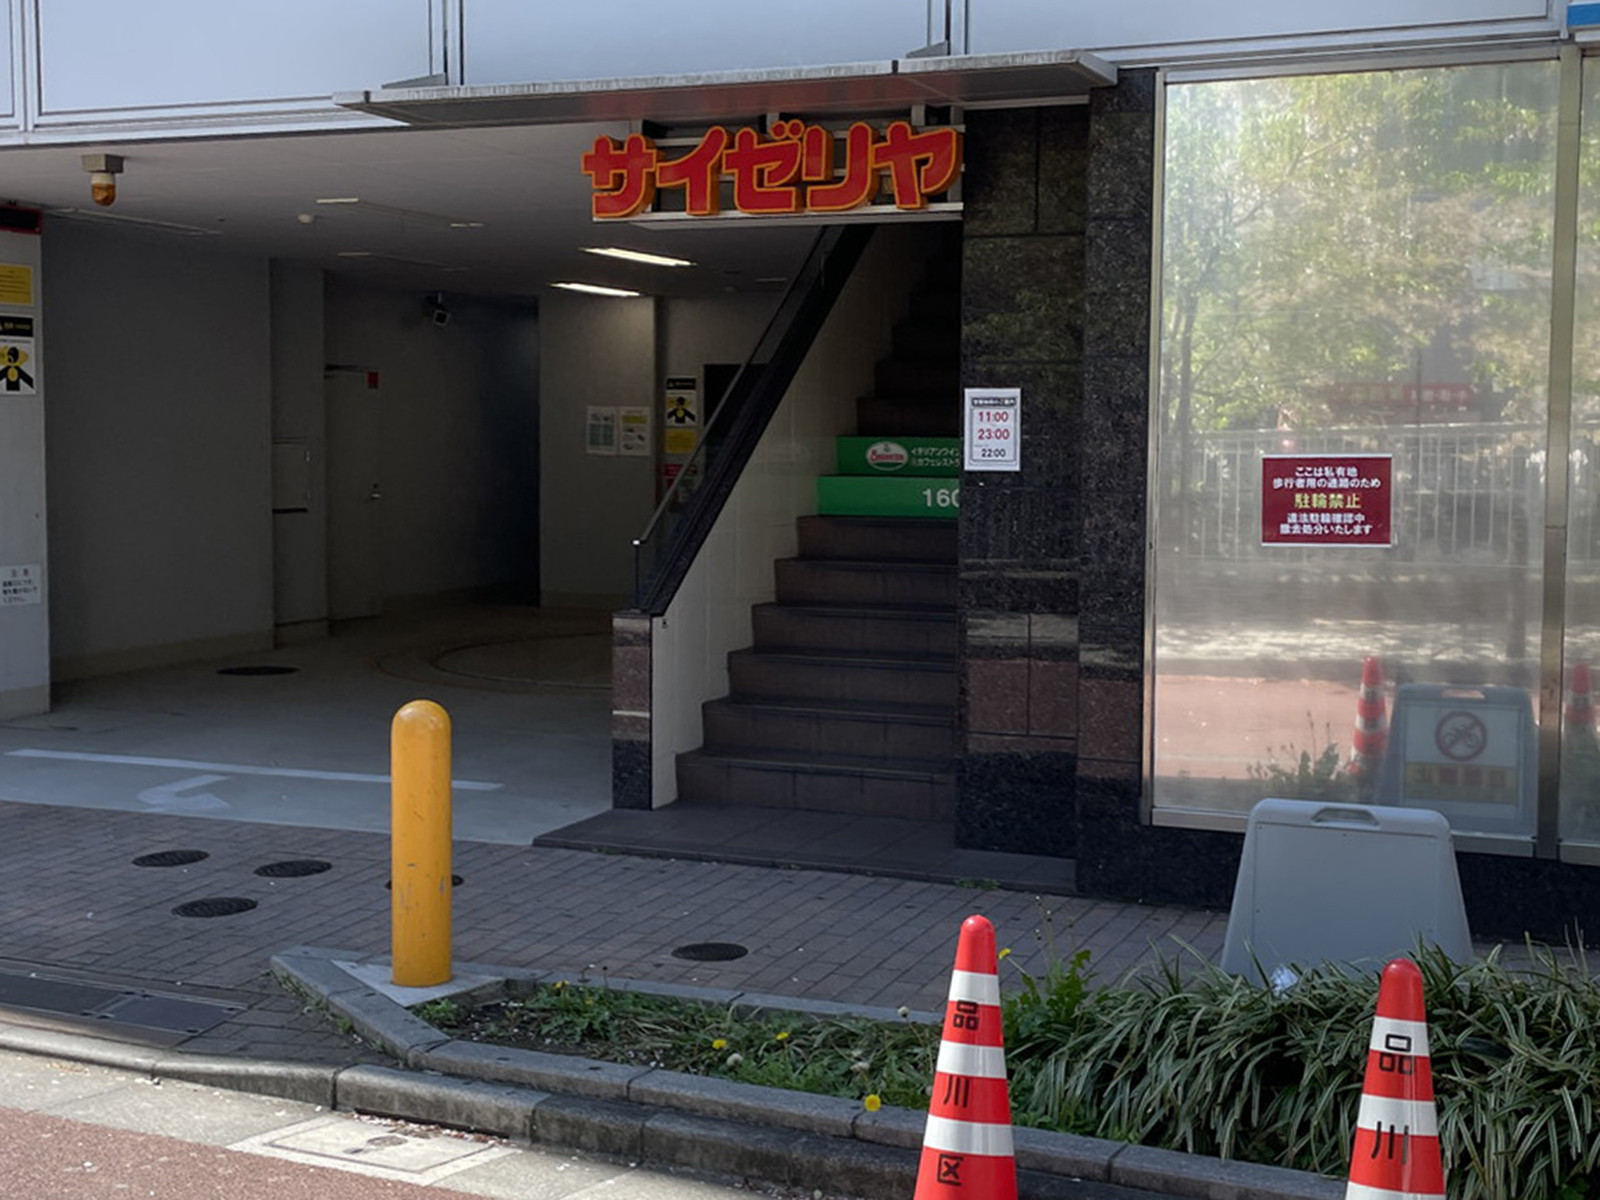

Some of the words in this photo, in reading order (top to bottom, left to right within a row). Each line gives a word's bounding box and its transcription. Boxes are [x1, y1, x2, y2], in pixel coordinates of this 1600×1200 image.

[581, 119, 963, 218] サイゼリヤ
[978, 411, 1009, 422] 11:00
[978, 428, 1010, 440] 23:00
[981, 448, 1006, 457] 22:00
[1295, 466, 1358, 478] ここは私有地
[1294, 493, 1362, 509] 駐輪禁止
[936, 1000, 980, 1186] 品川区
[1371, 1034, 1414, 1165] 品川
